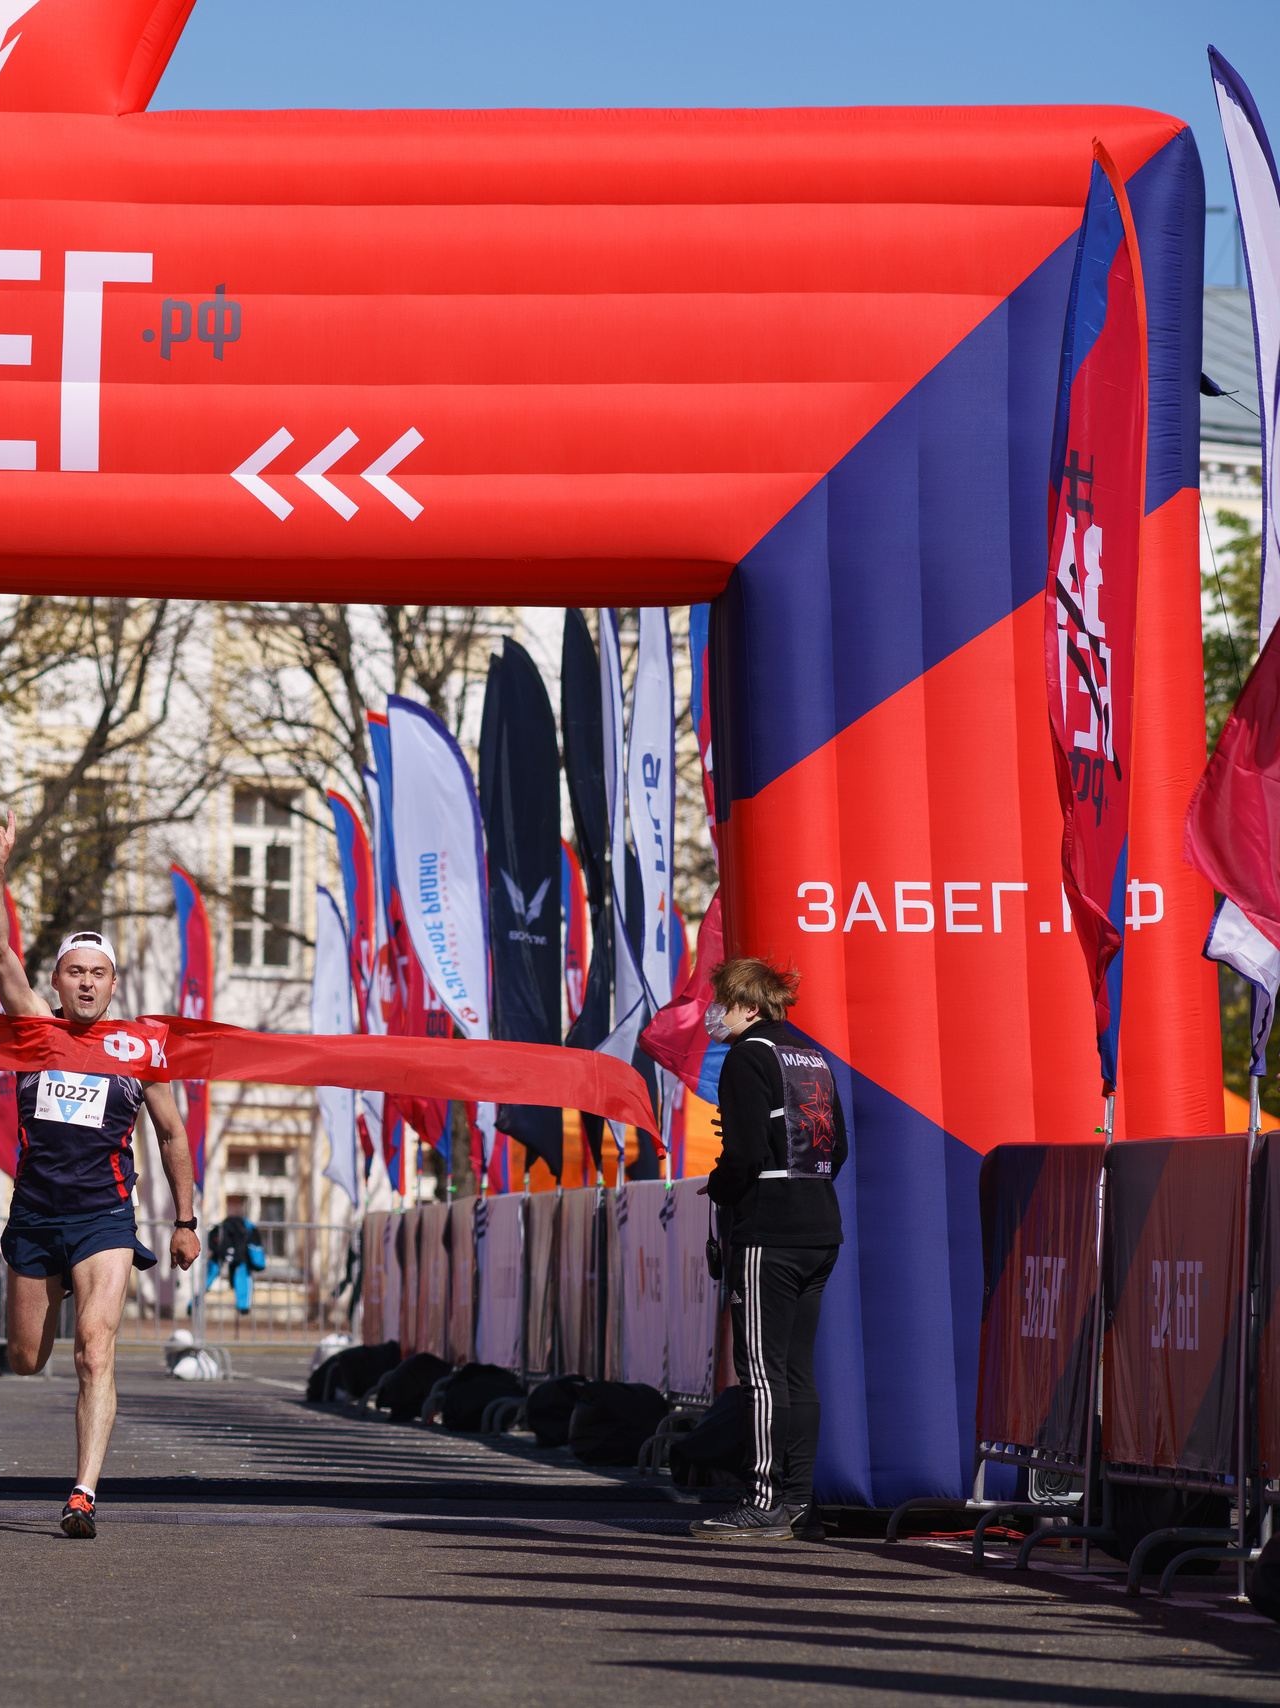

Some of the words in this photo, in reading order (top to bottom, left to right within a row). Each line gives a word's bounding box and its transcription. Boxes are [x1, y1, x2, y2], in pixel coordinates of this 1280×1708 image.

[797, 879, 1165, 934] ЗАБЕГ.Ф
[45, 1082, 100, 1103] 10227
[65, 1104, 72, 1112] 5
